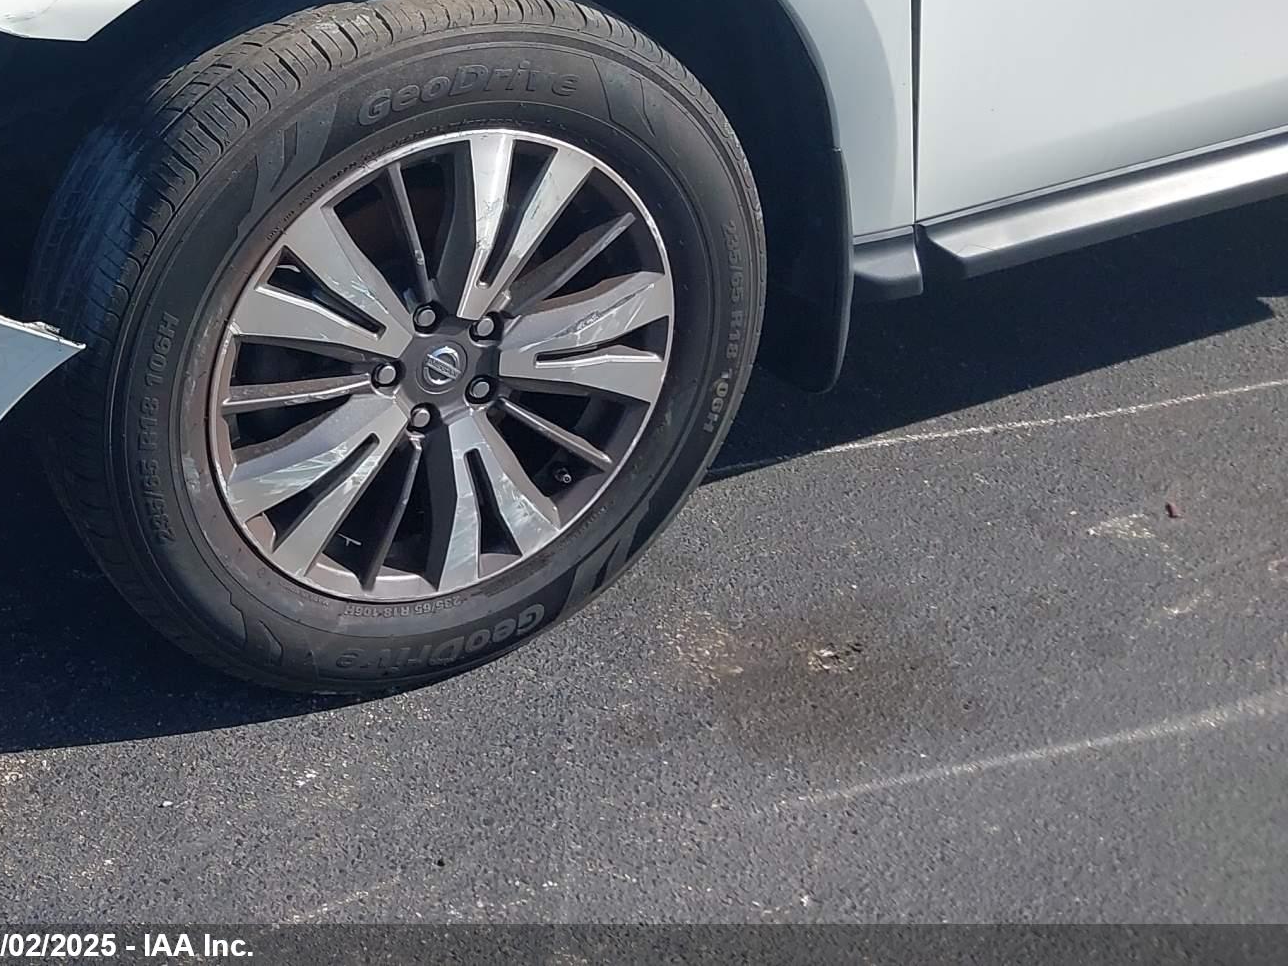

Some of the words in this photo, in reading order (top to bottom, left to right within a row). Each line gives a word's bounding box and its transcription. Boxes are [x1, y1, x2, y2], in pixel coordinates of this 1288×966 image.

[358, 59, 581, 127] GeoDrive
[721, 219, 745, 304] 235/65
[145, 312, 179, 387] 106H
[725, 309, 745, 360] R18
[702, 368, 734, 434] 106H
[414, 595, 462, 615] 235/65
